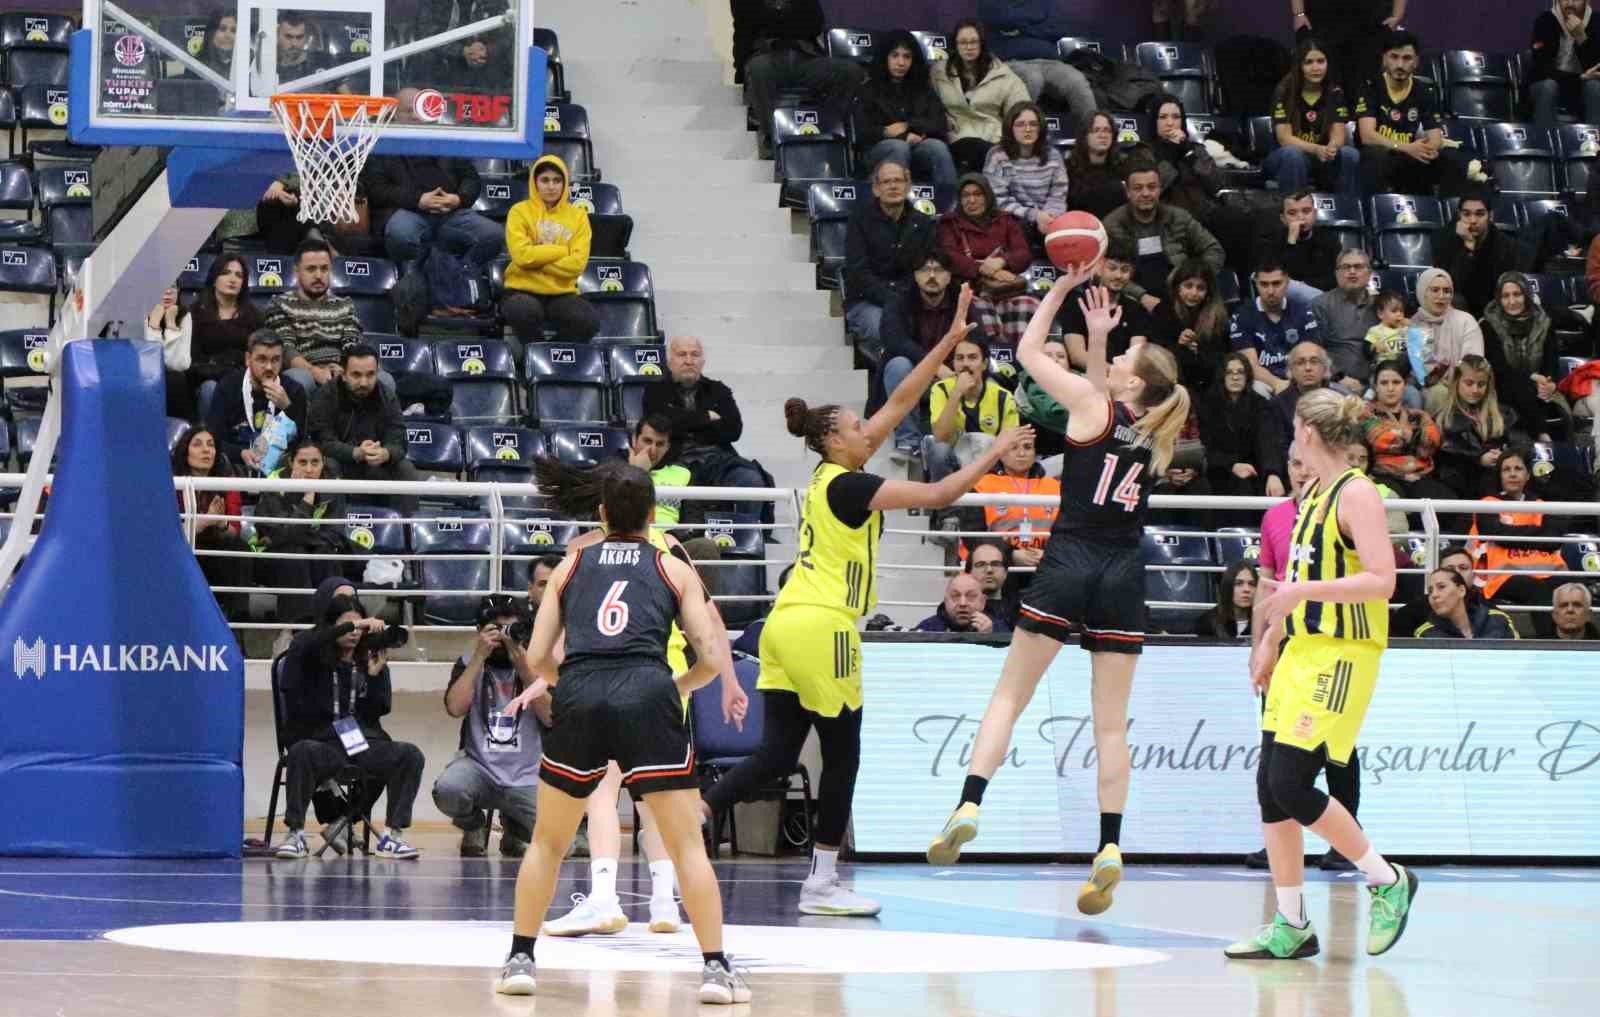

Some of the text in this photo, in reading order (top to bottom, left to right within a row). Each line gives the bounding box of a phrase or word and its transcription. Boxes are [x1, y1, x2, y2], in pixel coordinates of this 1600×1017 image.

[1092, 452, 1145, 512] 14
[598, 549, 641, 566] AKBAŞ
[597, 580, 630, 637] 6
[53, 644, 229, 672] HALKBANK
